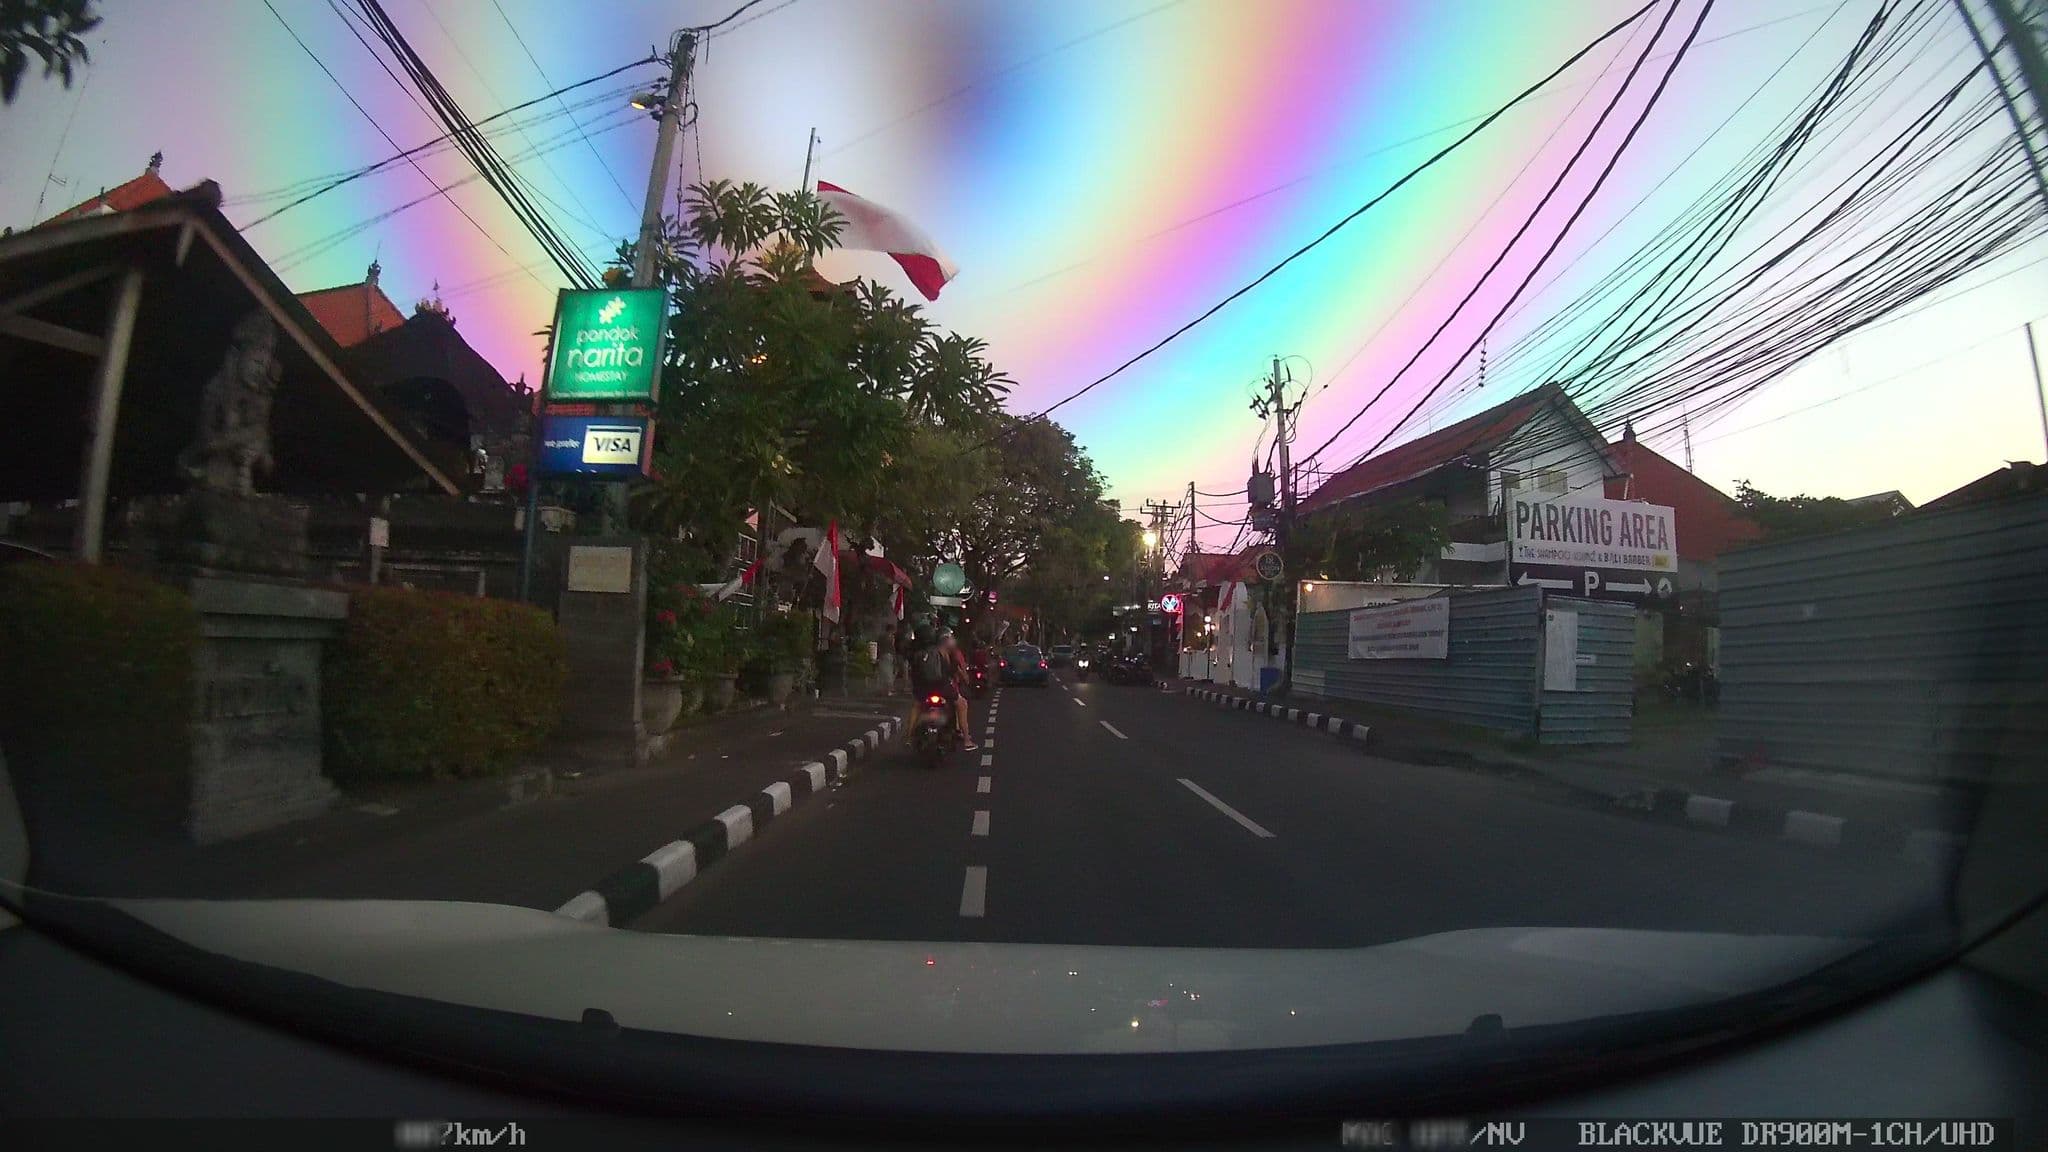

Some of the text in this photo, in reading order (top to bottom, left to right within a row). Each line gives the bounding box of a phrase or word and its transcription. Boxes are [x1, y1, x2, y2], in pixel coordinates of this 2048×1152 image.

[578, 326, 638, 344] pondok
[568, 342, 643, 368] narita
[594, 437, 631, 452] VISA
[1517, 501, 1669, 551] PARKING AREA
[1603, 553, 1622, 563] BALI
[1624, 555, 1651, 565] BARBER
[1585, 571, 1600, 596] P
